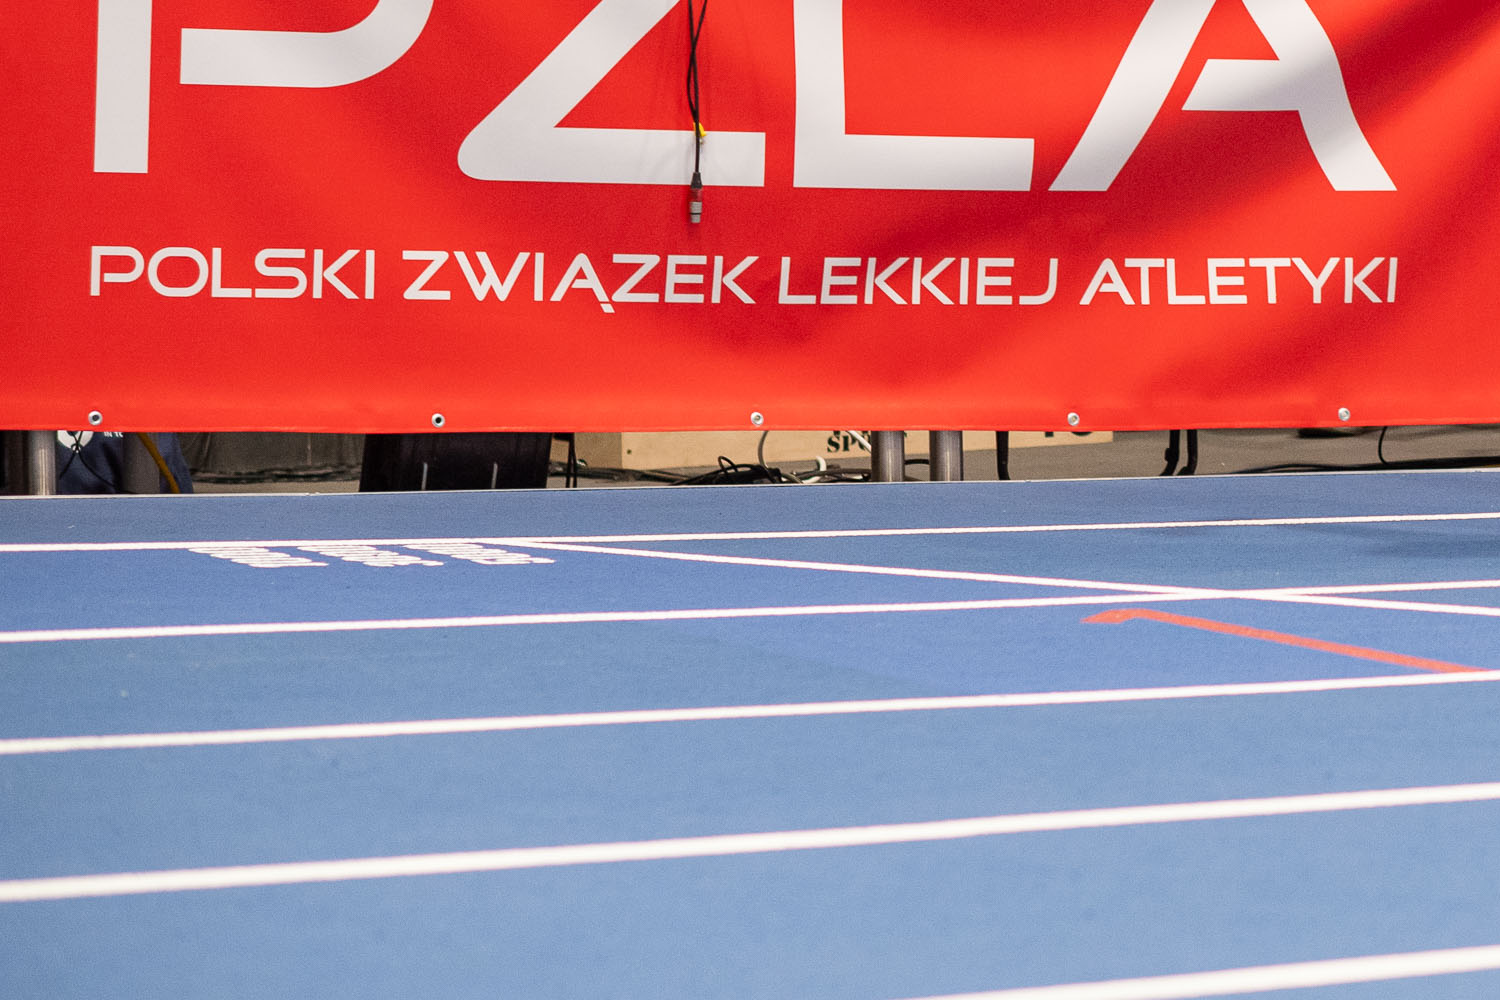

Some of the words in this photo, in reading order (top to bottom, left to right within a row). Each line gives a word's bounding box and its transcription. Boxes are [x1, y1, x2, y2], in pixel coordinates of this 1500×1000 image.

[90, 245, 375, 299] POLSKI
[402, 250, 759, 313] ZWIĄZEK
[779, 255, 1059, 306] LEKKIEJ
[1079, 256, 1398, 305] ATLETYKI
